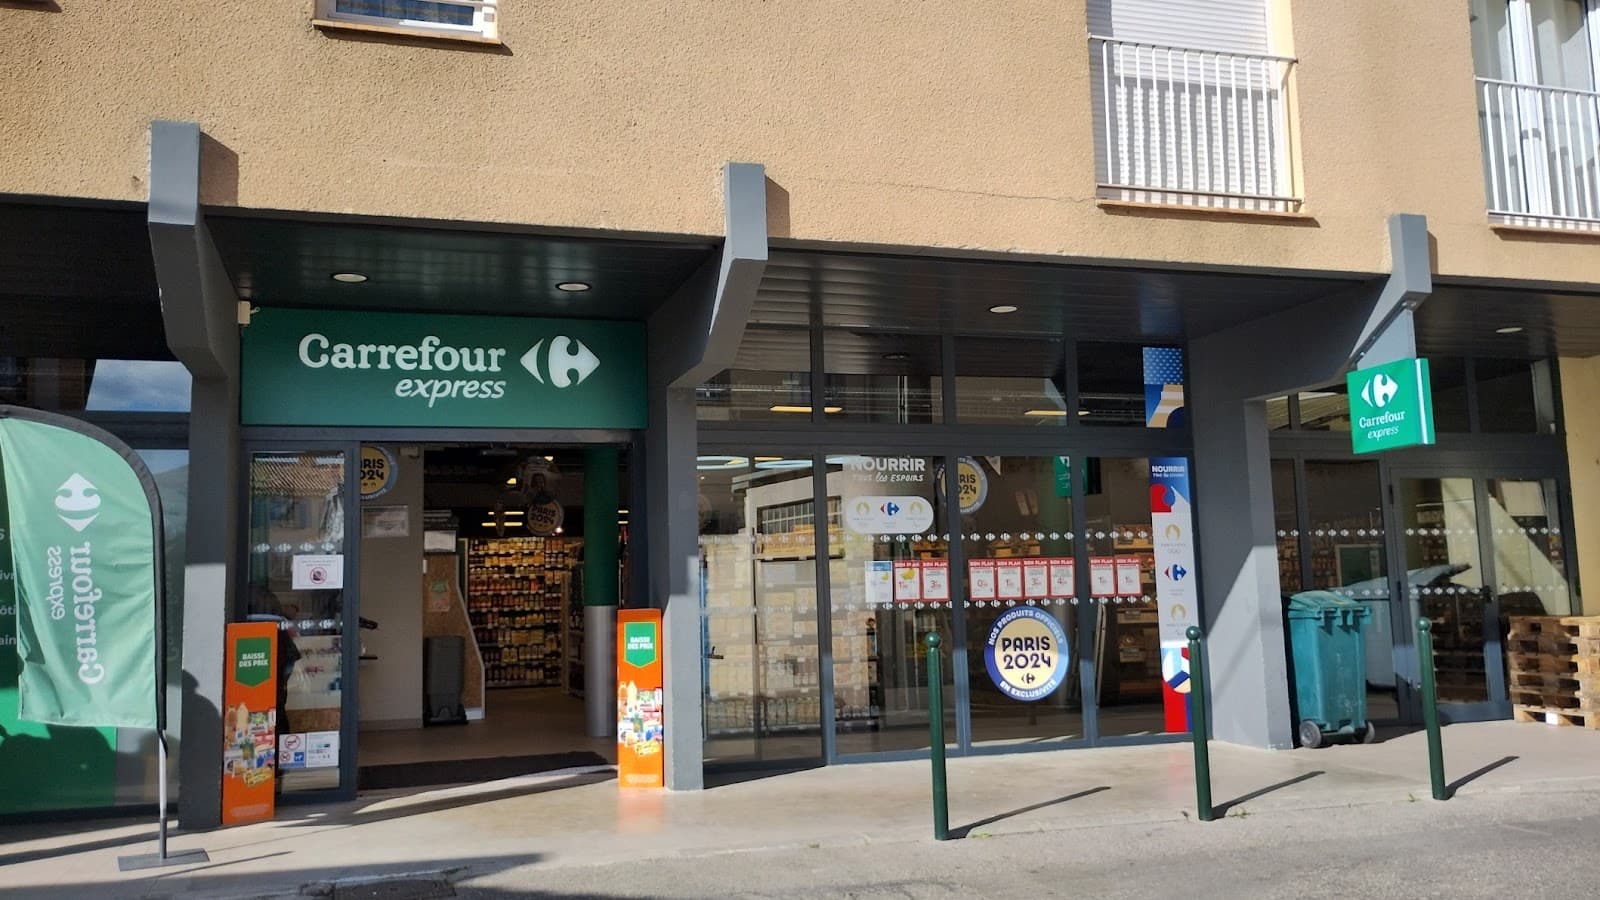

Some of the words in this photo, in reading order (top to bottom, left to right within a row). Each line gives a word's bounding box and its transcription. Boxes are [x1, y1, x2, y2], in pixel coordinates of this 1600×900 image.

[298, 332, 506, 372] Carrefour
[394, 377, 506, 408] express
[1359, 410, 1406, 429] Carrefour
[1367, 425, 1400, 442] express
[360, 458, 385, 469] RIS
[850, 457, 926, 472] NOURRIR
[891, 473, 924, 482] ESPOIRS
[959, 473, 976, 484] RIS
[988, 628, 999, 646] NOS
[998, 609, 1034, 628] PRODUITS
[1001, 636, 1051, 652] PARIS
[239, 660, 252, 668] DES
[253, 659, 269, 667] PRIX
[1003, 652, 1051, 670] 2024
[1000, 679, 1010, 692] EN
